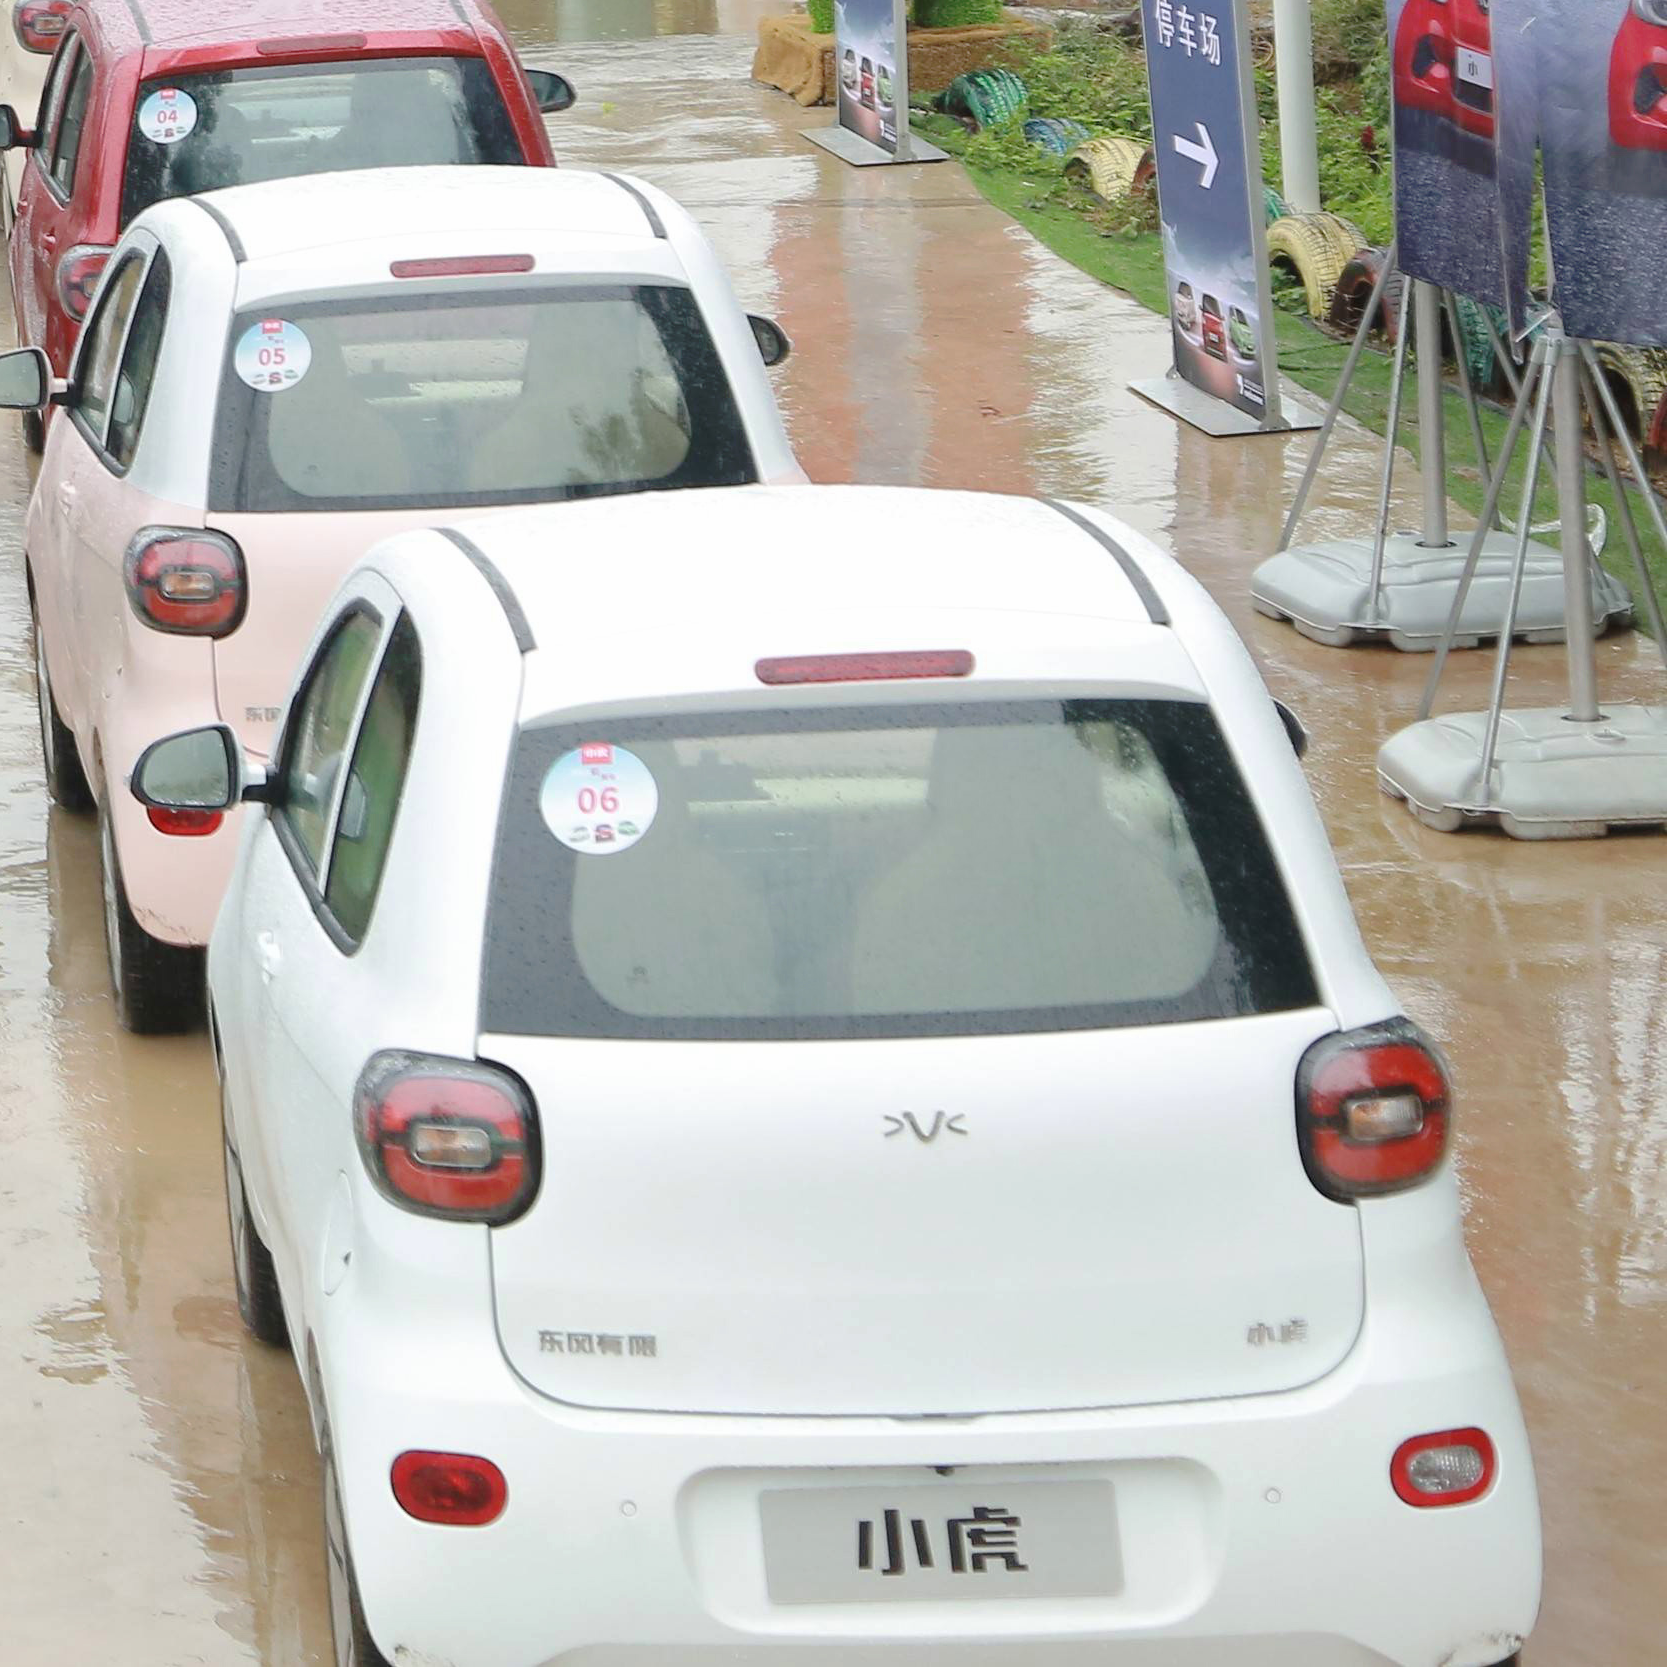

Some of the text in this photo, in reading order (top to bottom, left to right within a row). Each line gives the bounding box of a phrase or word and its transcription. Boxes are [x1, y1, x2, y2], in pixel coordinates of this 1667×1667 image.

[157, 109, 178, 125] 04
[258, 347, 286, 367] 05
[577, 786, 619, 815] 06
[858, 1506, 1029, 1576] 小虎
